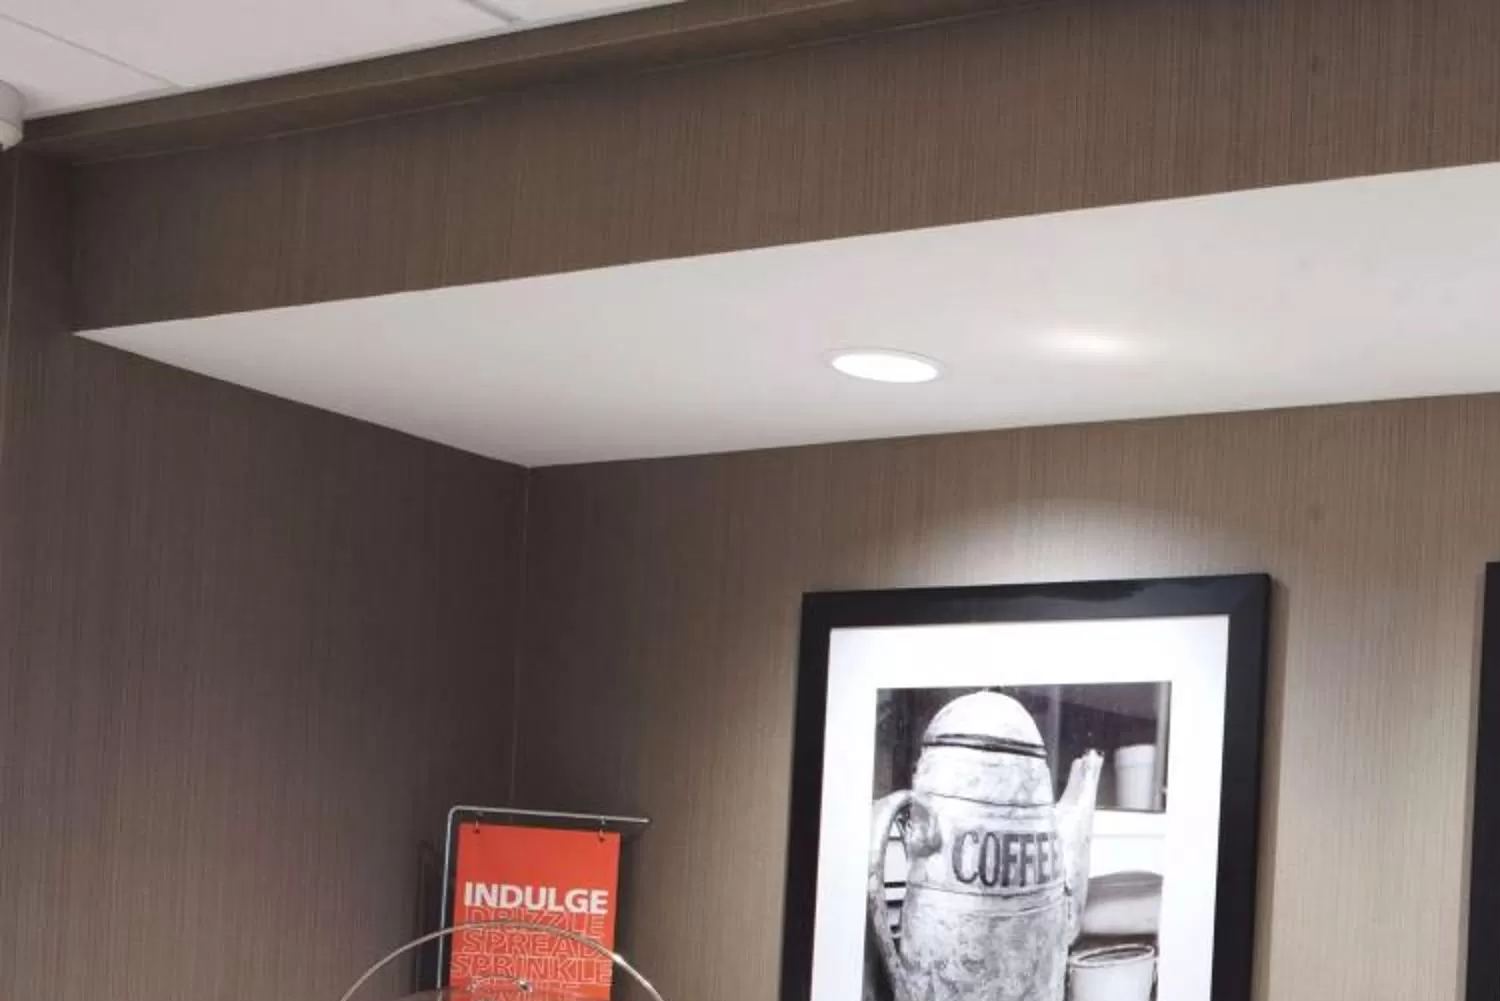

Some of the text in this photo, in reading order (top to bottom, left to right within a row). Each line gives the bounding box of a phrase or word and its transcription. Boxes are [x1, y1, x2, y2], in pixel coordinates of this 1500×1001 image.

[463, 881, 609, 915] INDULGE
[462, 928, 605, 959] SPREAD
[450, 953, 613, 987] SPRINKLE
